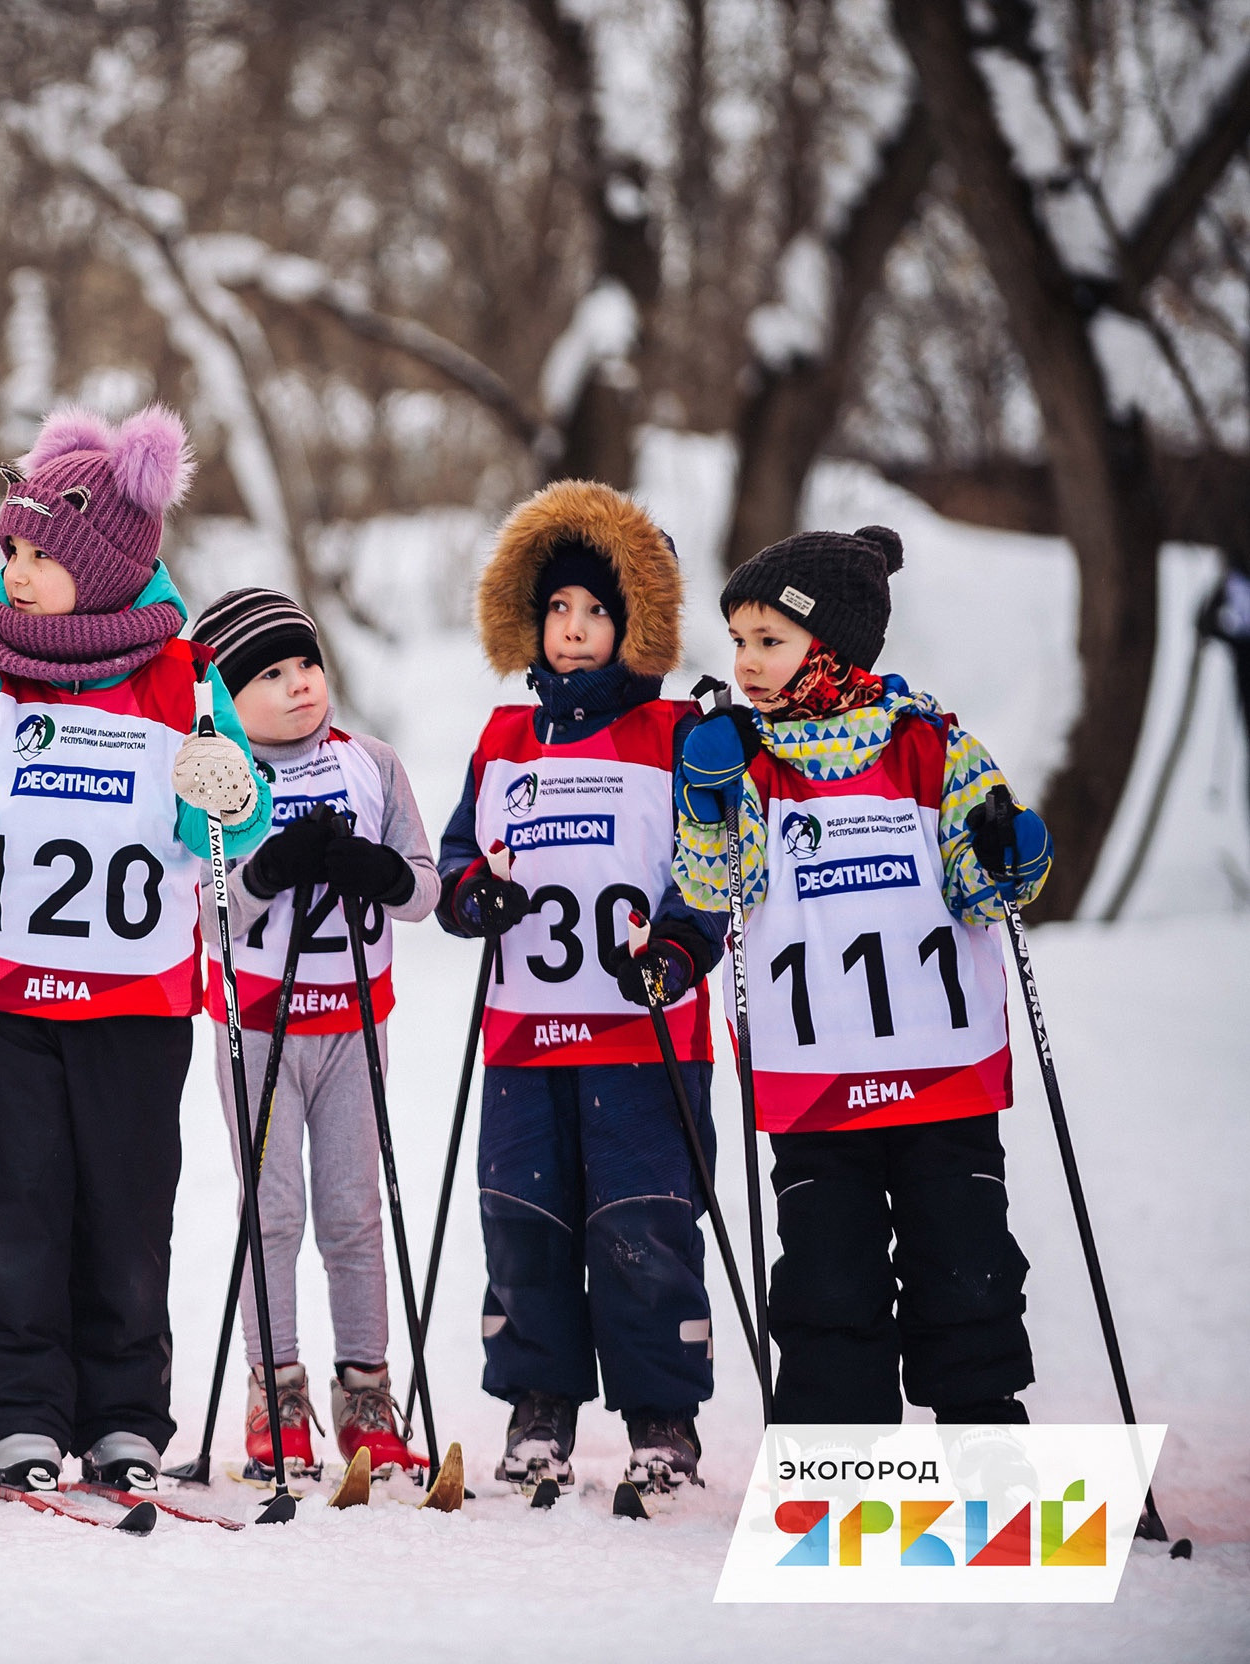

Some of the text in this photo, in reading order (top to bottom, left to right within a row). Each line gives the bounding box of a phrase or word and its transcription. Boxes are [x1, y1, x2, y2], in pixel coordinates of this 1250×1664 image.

[60, 736, 146, 750] РЕСПУБЛИКИ БАШКОРТОСТАН
[61, 726, 147, 739] ФЕДЕРАЦИЯ ЛЫЖНЫХ ГОНОК
[18, 771, 128, 797] DECATHLON
[540, 777, 574, 786] ФЕДЕРАЦИЯ
[540, 786, 624, 796] РЕСПУБЛИКИ БАШКОРТОСТАН
[510, 820, 608, 846] DECATHLON
[827, 815, 866, 827] ФЕДЕРАЦИЯ
[893, 813, 915, 824] ГОНОК
[828, 824, 918, 838] РЕСПУБЛИКИ БАШКОРТОСТАН
[210, 824, 226, 902] NORDWAY
[798, 861, 913, 892] DECATHLON
[731, 896, 747, 1017] UNIVERSAL
[24, 974, 91, 1001] ДЁМА
[770, 925, 969, 1046] 111
[1011, 913, 1054, 1067] UNIVERSAL
[289, 990, 350, 1014] ДЁМА
[228, 1011, 239, 1059] XC ACTIVE
[534, 1019, 592, 1046] ДЁМА
[847, 1079, 916, 1109] ДЁМА
